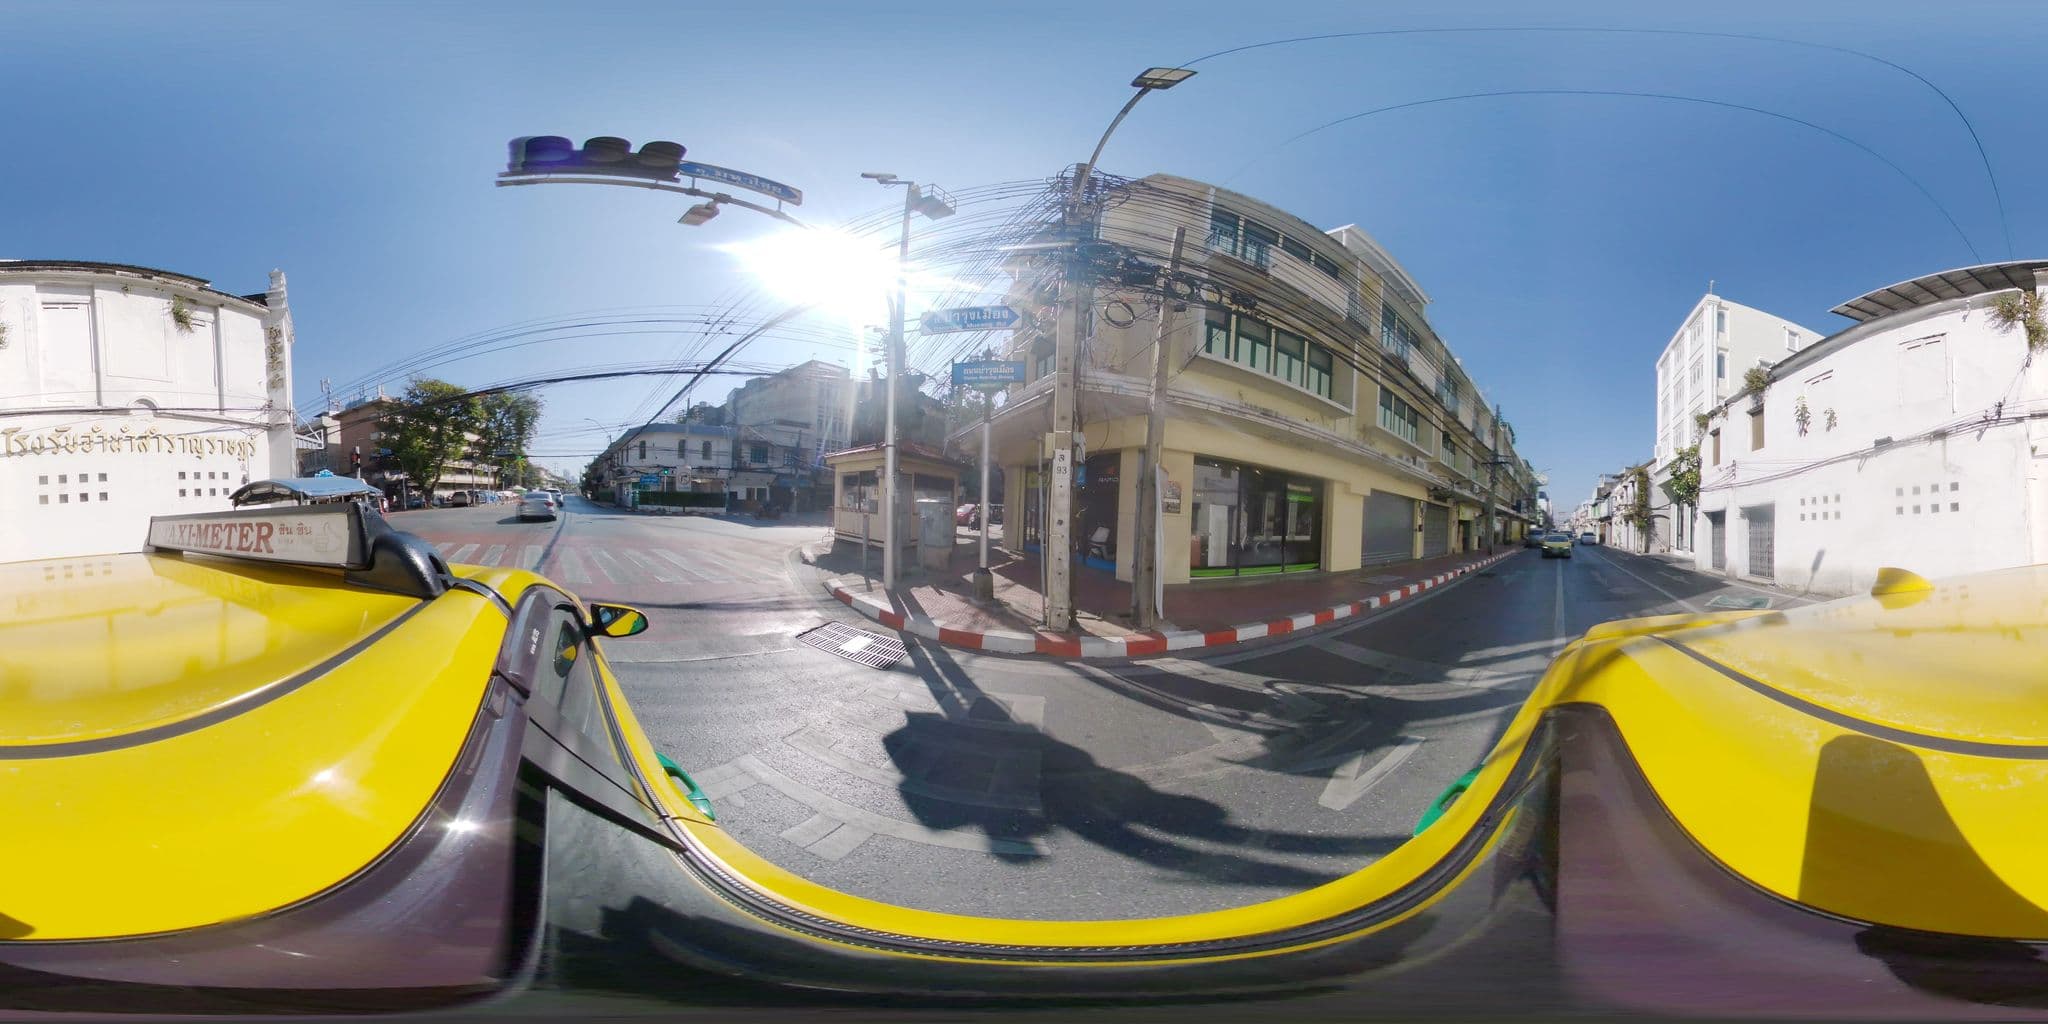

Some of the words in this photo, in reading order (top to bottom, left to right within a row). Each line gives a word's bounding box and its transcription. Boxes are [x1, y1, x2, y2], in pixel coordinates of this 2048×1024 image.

[1, 424, 257, 462] โรงรับจำนำสำราญราษฎร์
[1056, 466, 1067, 475] 93
